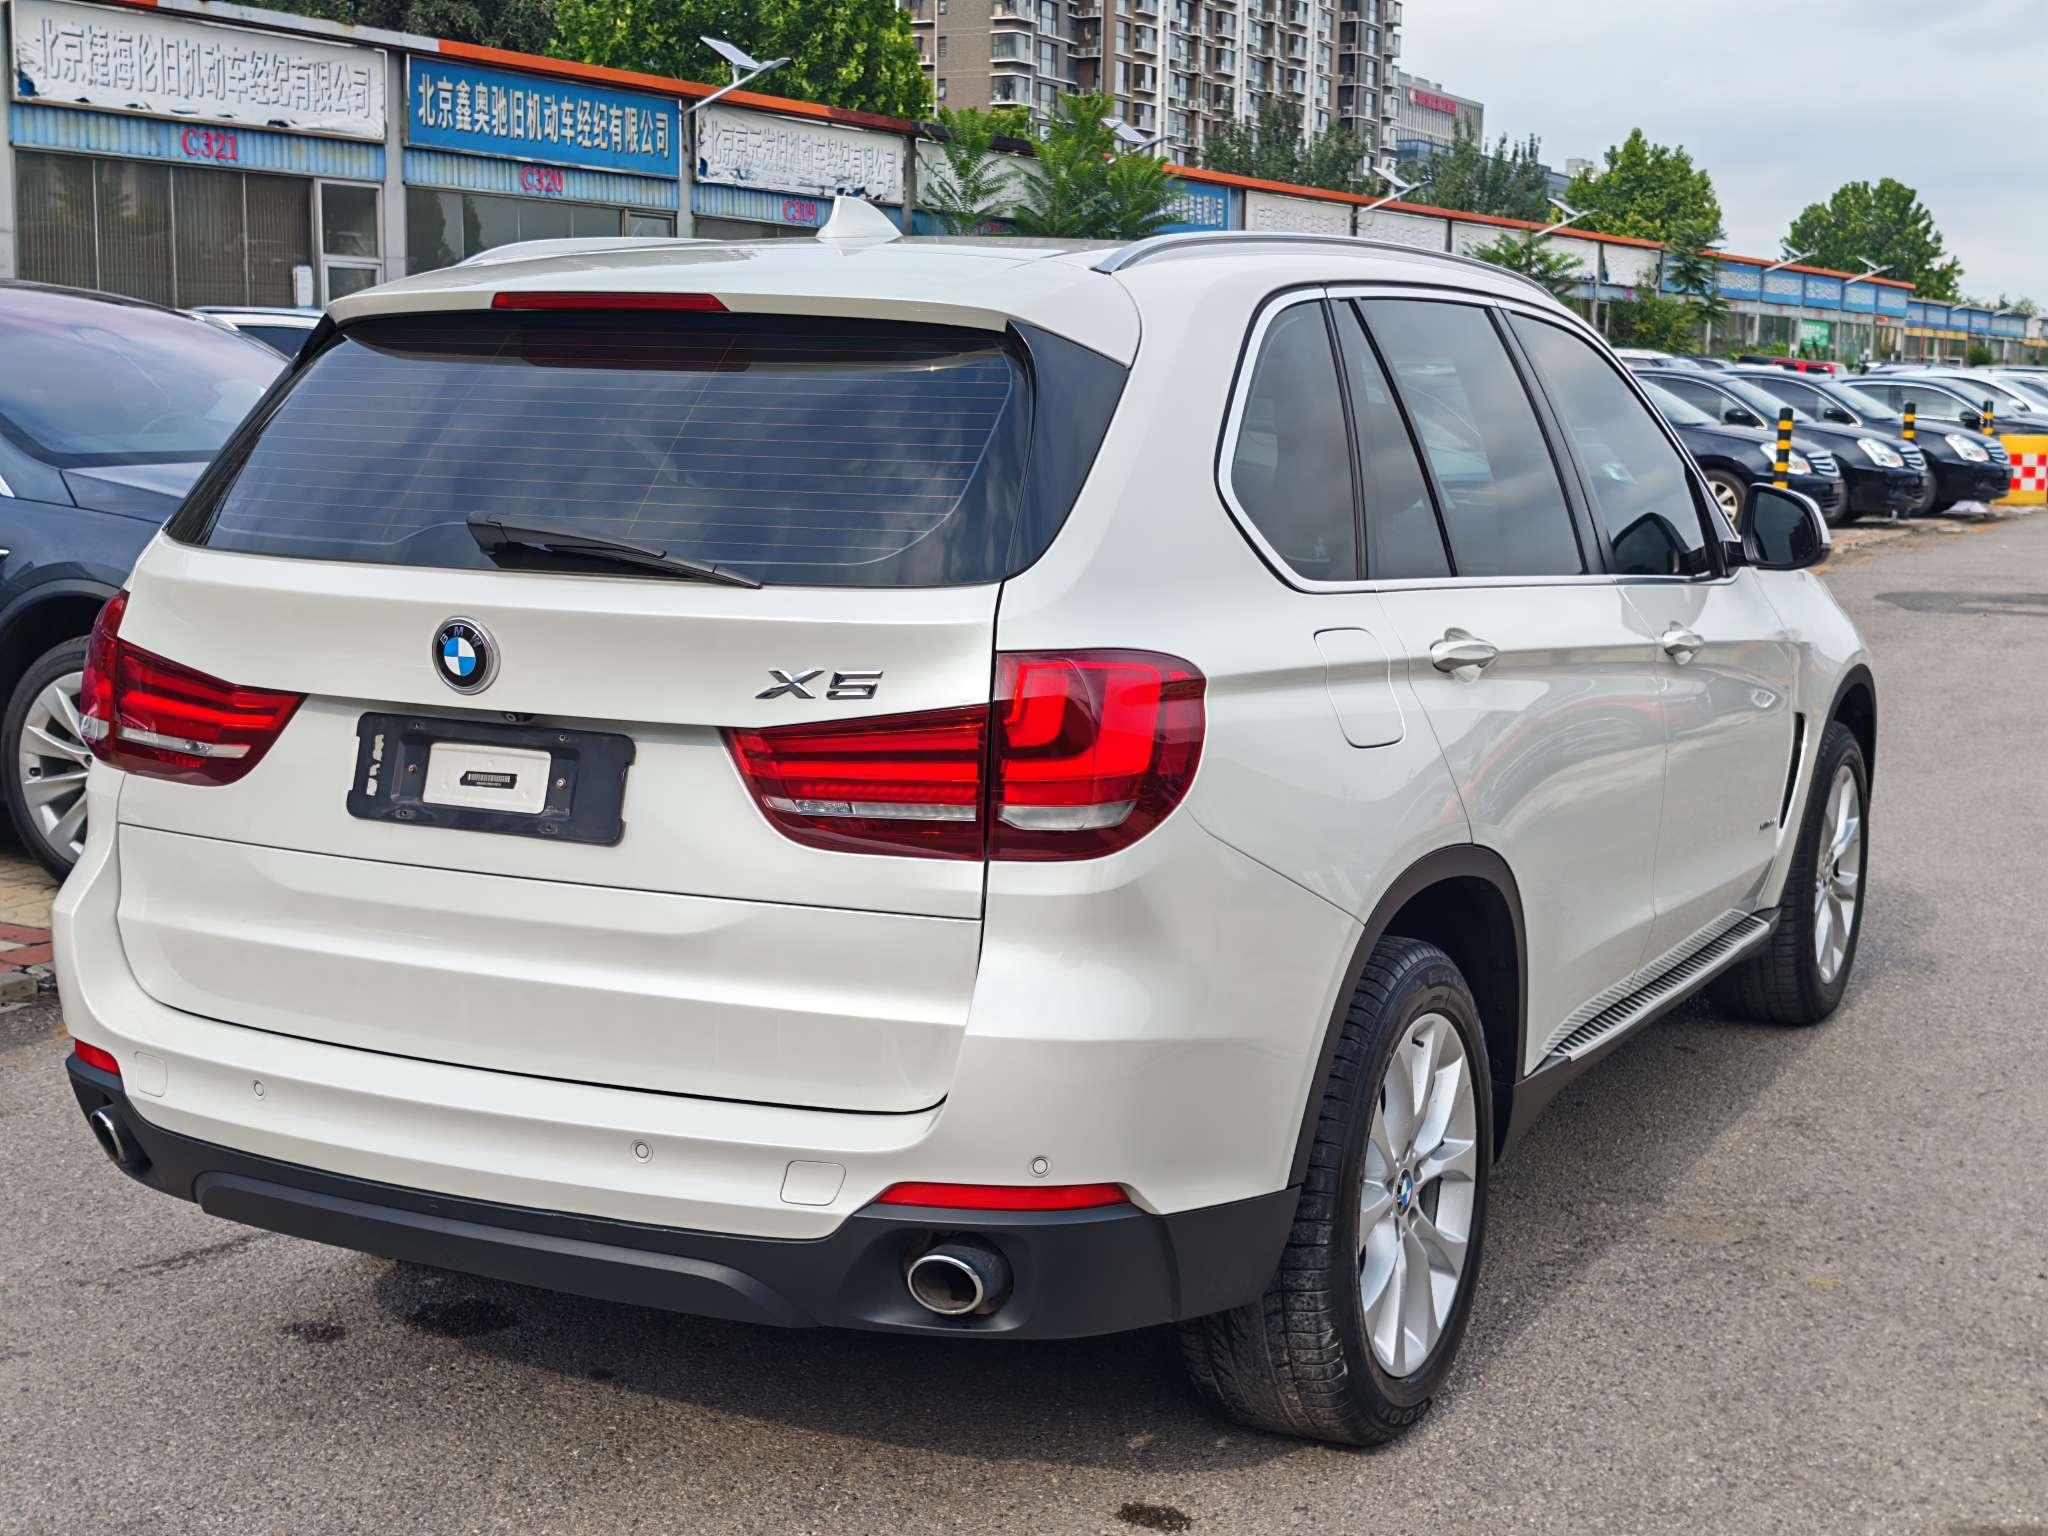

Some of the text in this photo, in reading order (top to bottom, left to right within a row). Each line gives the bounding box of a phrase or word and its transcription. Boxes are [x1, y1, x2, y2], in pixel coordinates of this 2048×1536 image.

[417, 72, 671, 159] 北京鑫奥驰旧机动车经纪有限公司
[182, 127, 239, 161] C321
[520, 165, 565, 192] C320
[782, 199, 817, 222] C319
[440, 626, 482, 648] BMW
[755, 670, 883, 700] X5
